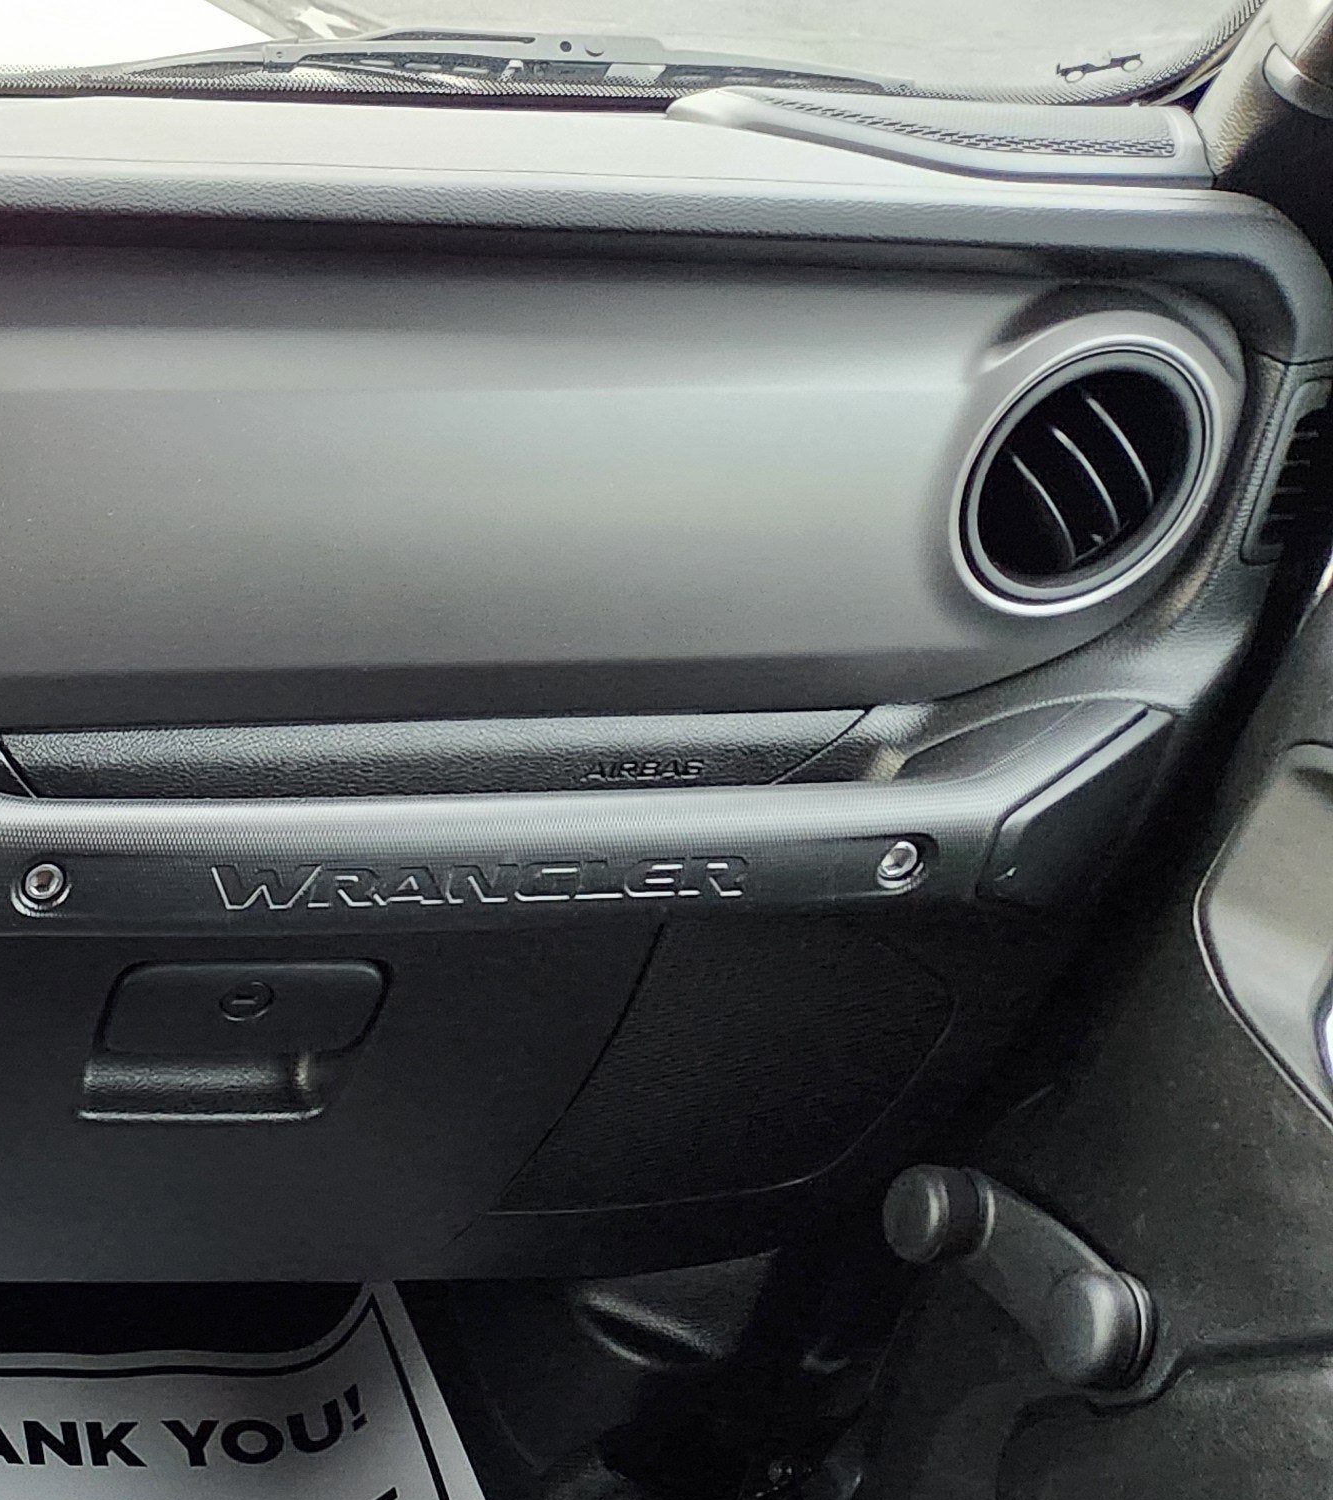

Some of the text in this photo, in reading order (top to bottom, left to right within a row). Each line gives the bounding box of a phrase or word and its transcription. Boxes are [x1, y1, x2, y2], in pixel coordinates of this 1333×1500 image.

[581, 759, 705, 782] AIRBAG
[210, 856, 750, 911] WRANGLER
[161, 1384, 367, 1468] YOU!
